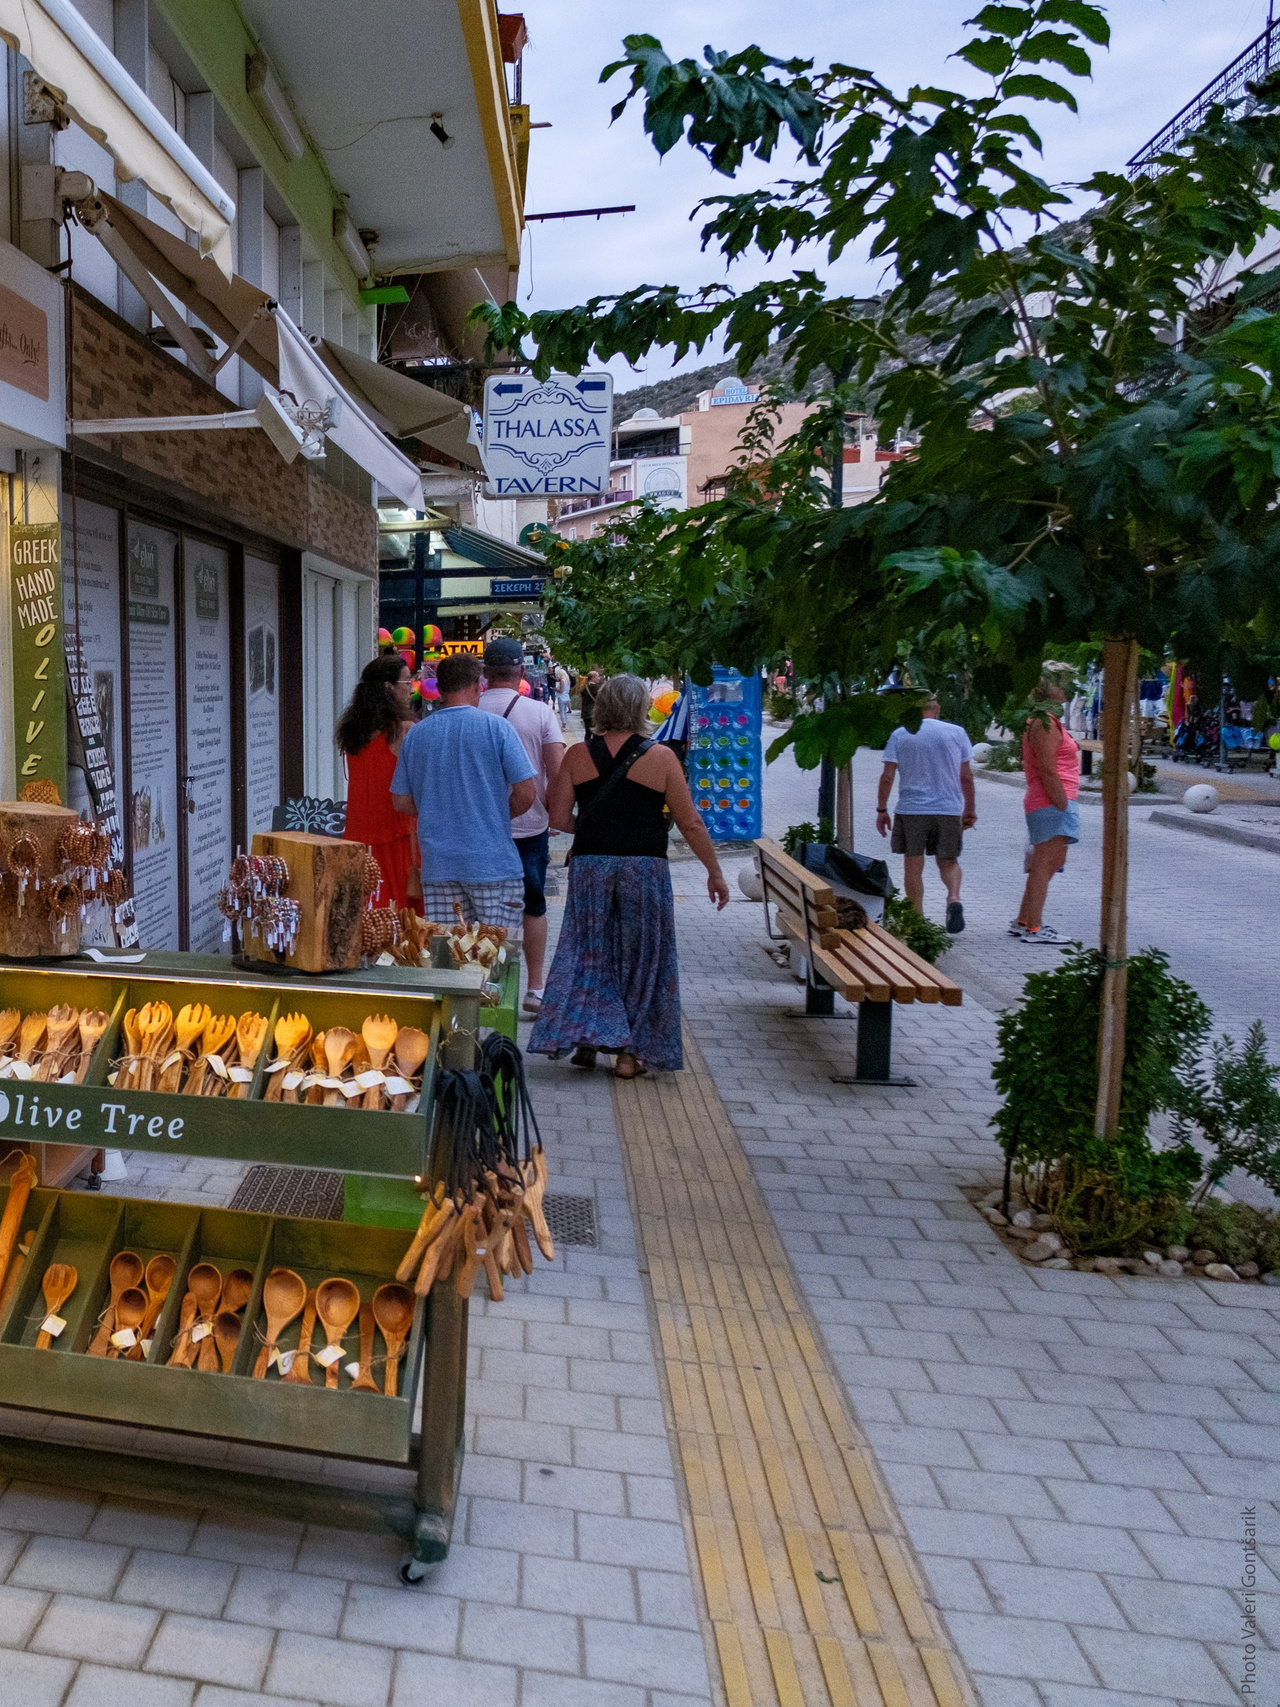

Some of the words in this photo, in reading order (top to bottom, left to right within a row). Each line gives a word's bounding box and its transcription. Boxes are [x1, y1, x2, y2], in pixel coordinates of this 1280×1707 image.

[19, 333, 41, 364] Only!
[493, 418, 601, 438] THALASSA
[495, 476, 602, 493] TAVERN
[13, 539, 58, 565] GREEK
[15, 568, 56, 602] HAND
[494, 583, 532, 593] ΣΕΚΕΡΗ
[17, 596, 58, 630] MADE
[440, 644, 478, 656] ATM
[21, 623, 56, 776] OLIVE
[100, 1102, 185, 1140] Tree
